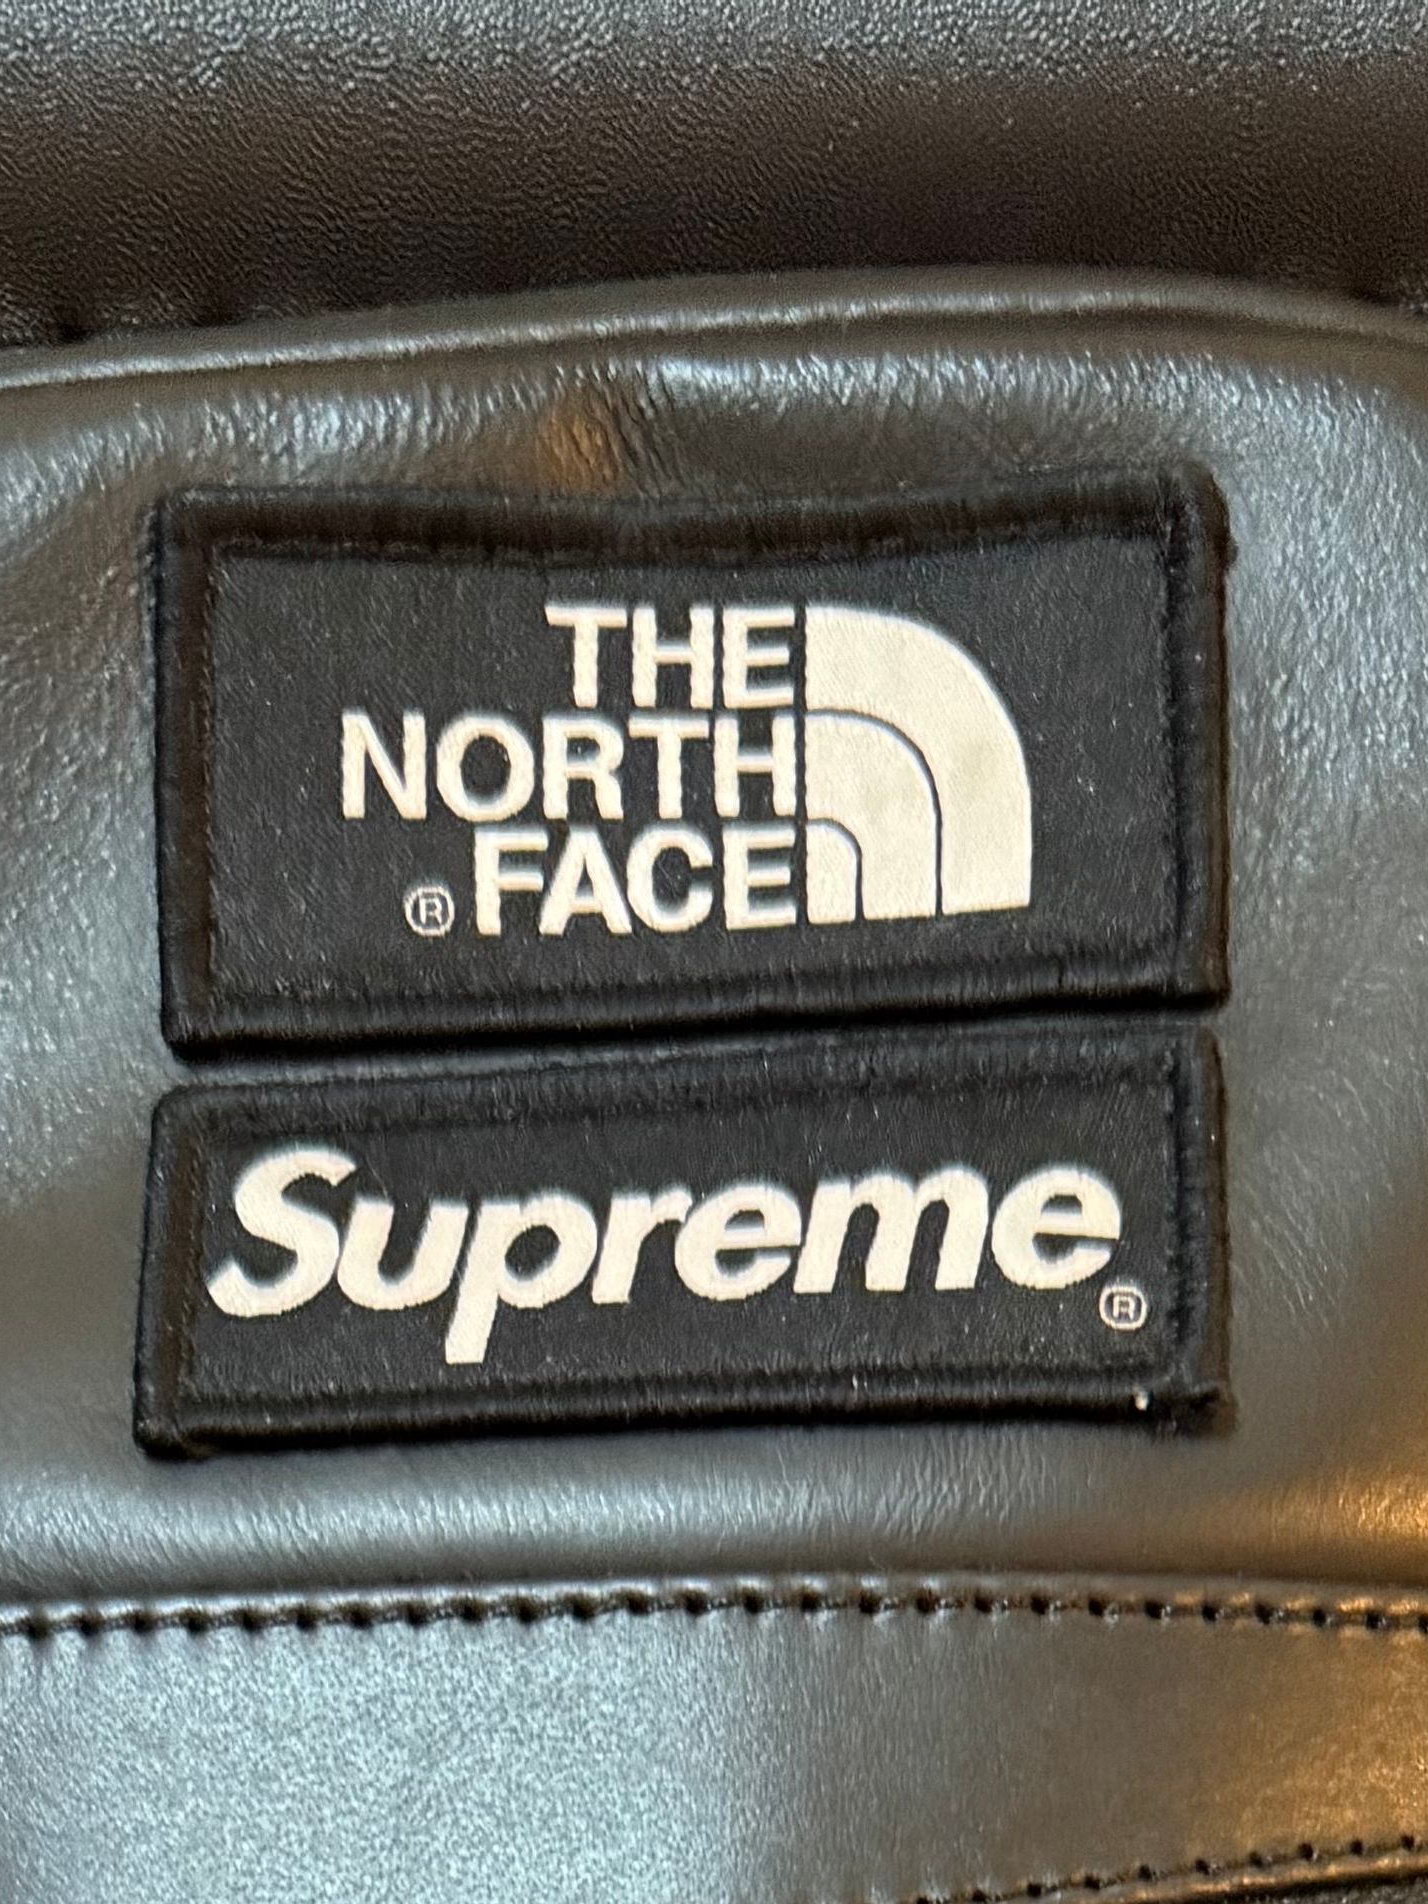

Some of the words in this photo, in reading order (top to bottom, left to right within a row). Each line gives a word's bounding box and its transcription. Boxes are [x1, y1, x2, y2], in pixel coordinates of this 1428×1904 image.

[544, 600, 797, 711] THE
[340, 709, 799, 823] NORTH
[473, 822, 798, 936] FACE
[206, 1143, 1123, 1366] Supreme
